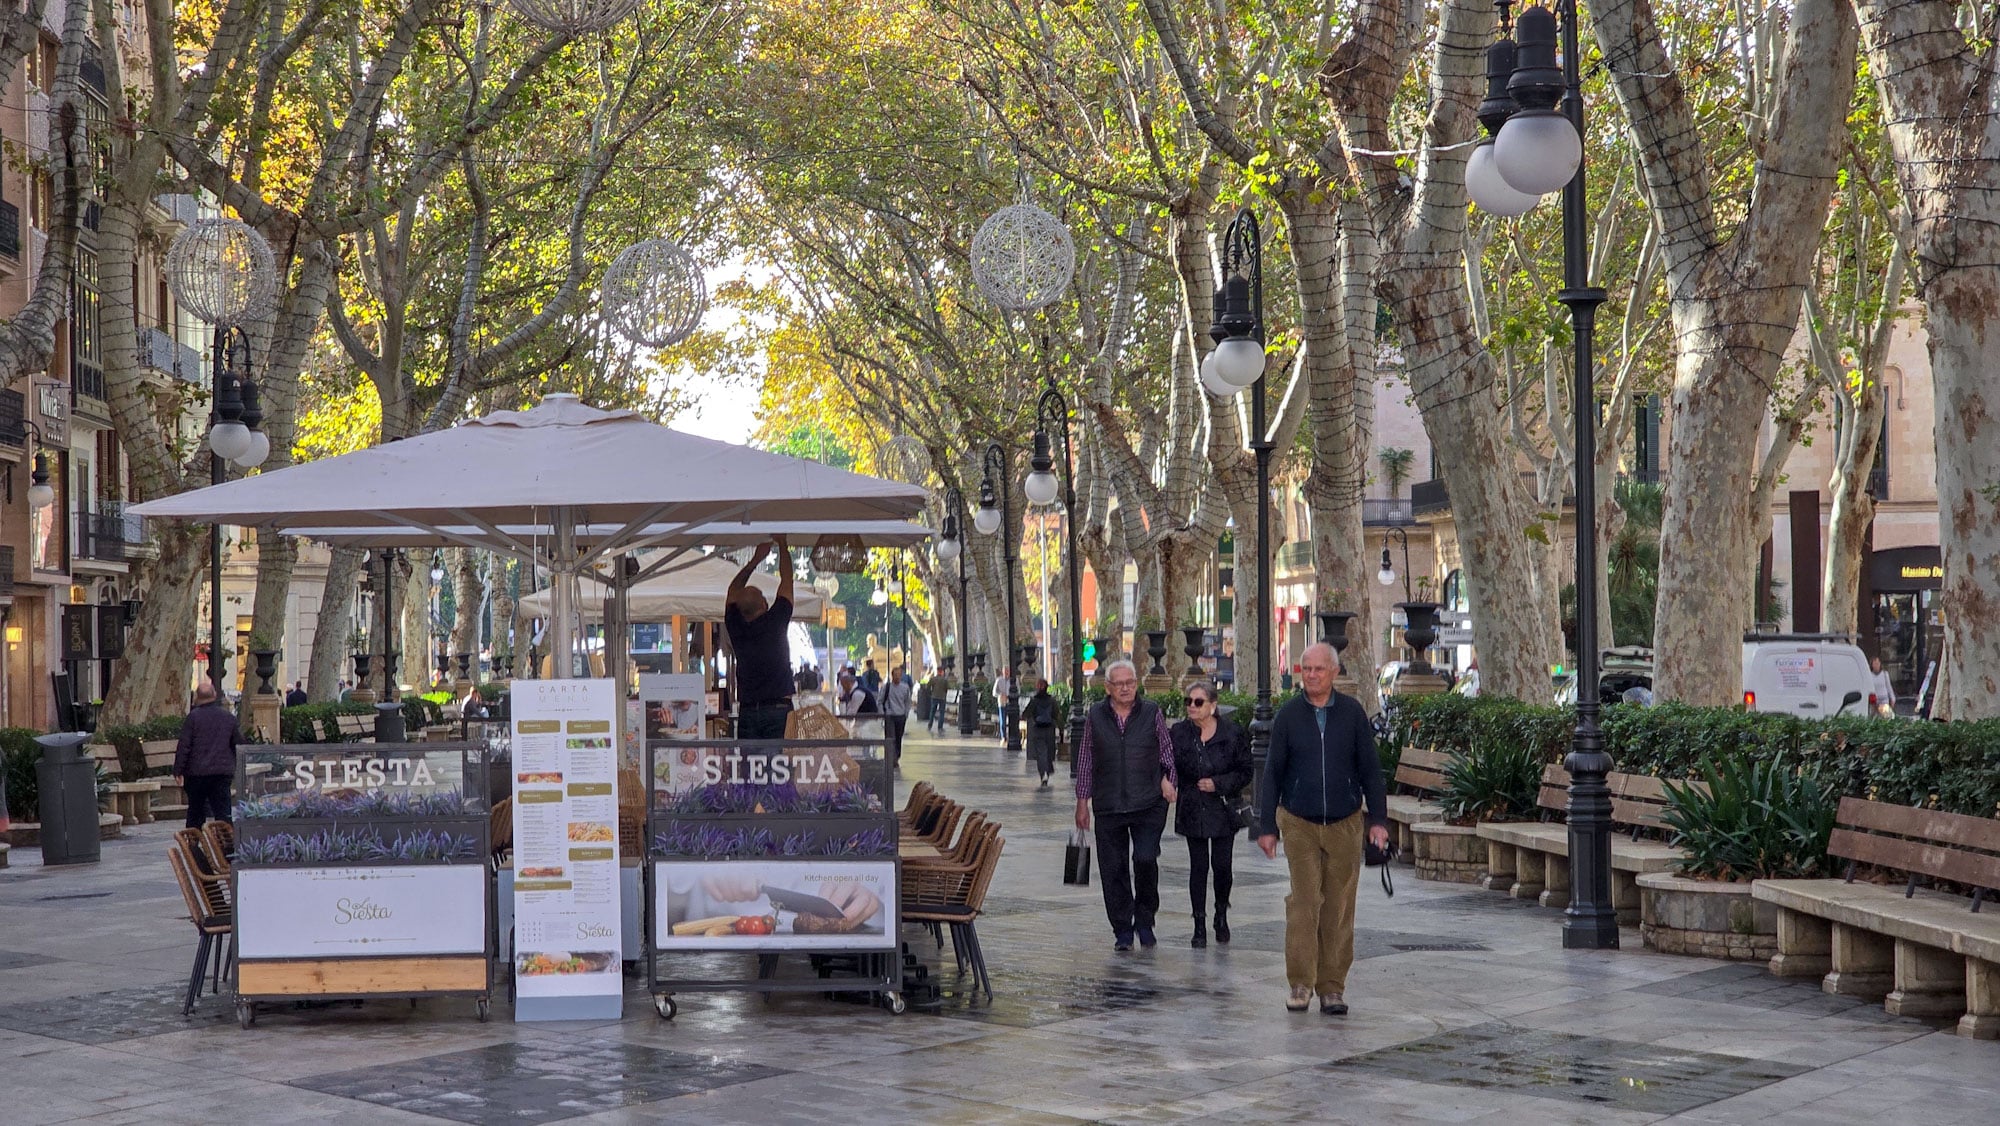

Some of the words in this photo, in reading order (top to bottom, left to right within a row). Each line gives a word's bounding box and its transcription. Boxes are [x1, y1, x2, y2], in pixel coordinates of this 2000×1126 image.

[71, 622, 80, 652] BORN
[538, 685, 589, 693] CARTA
[295, 758, 436, 790] SIESTA
[702, 754, 840, 786] SIESTA
[834, 875, 852, 883] open
[865, 874, 879, 883] day
[335, 897, 393, 925] Siesta
[576, 921, 615, 941] Siesta
